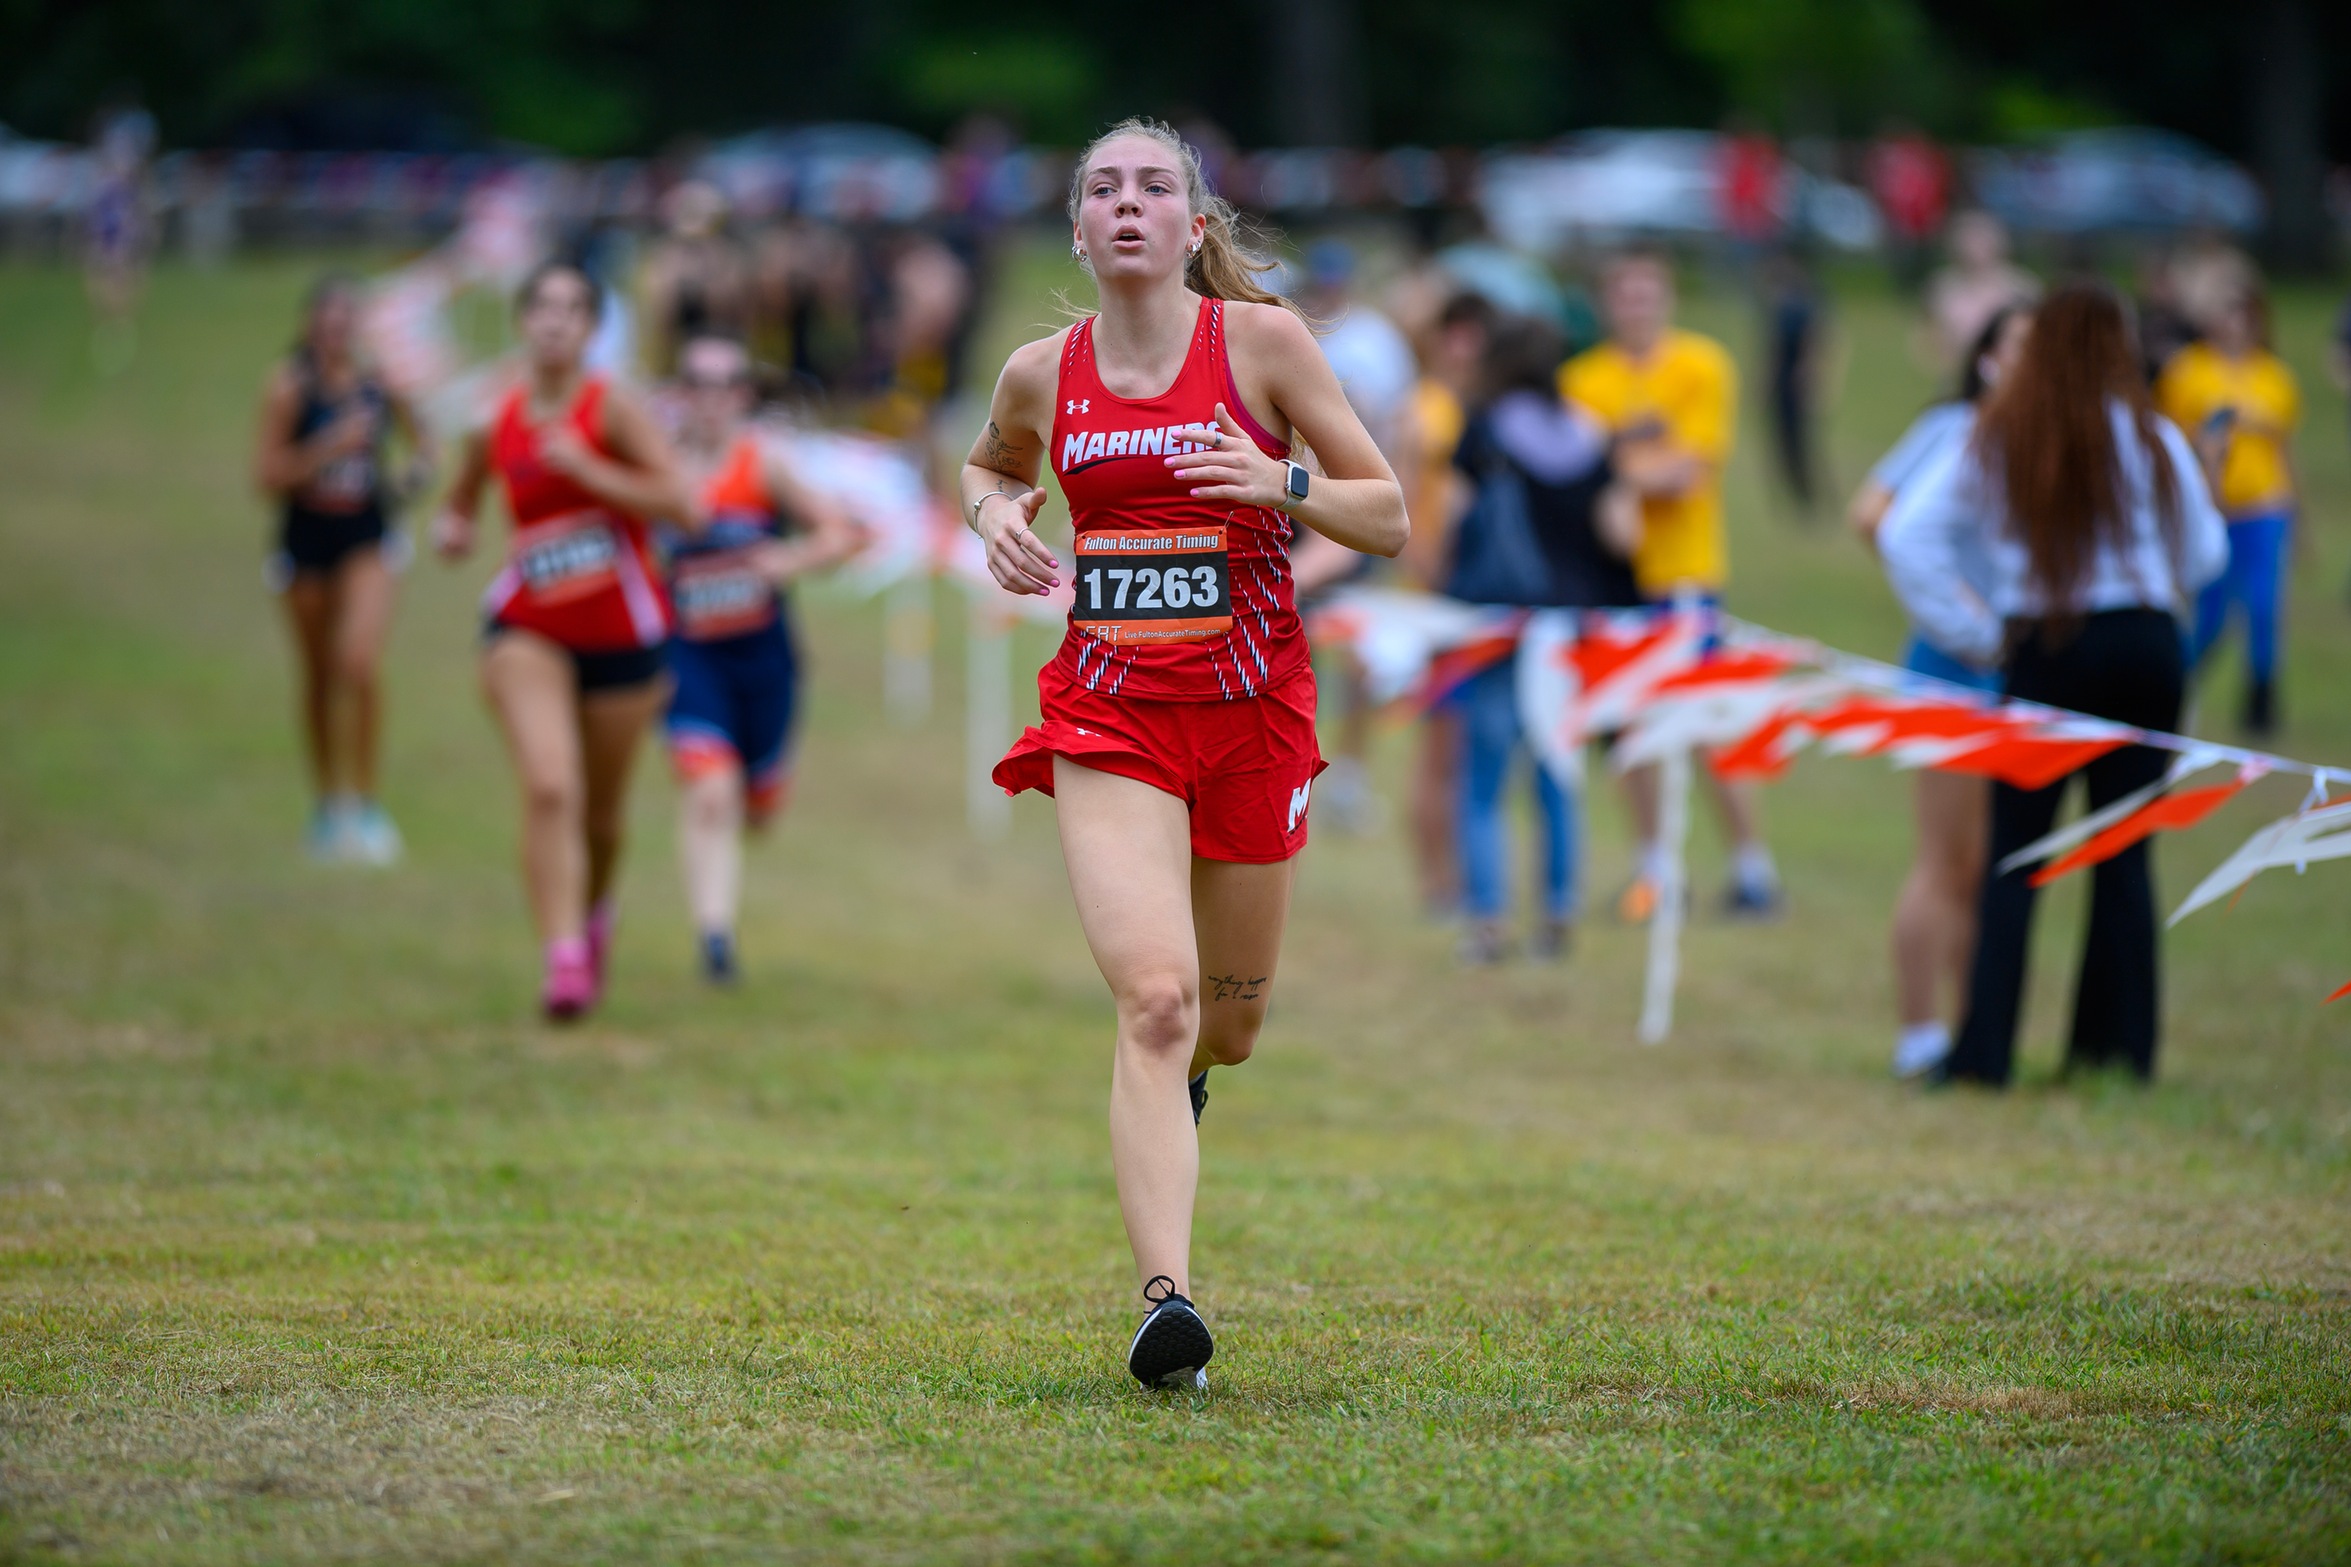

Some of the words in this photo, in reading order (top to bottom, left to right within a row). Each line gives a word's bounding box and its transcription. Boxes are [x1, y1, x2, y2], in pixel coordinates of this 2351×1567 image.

[1084, 537, 1117, 550] Fulton
[1119, 536, 1173, 550] Accurate
[1175, 534, 1219, 549] Timing
[1084, 565, 1219, 609] 17263
[1124, 629, 1221, 639] Live.FultonAccurateTiming.com
